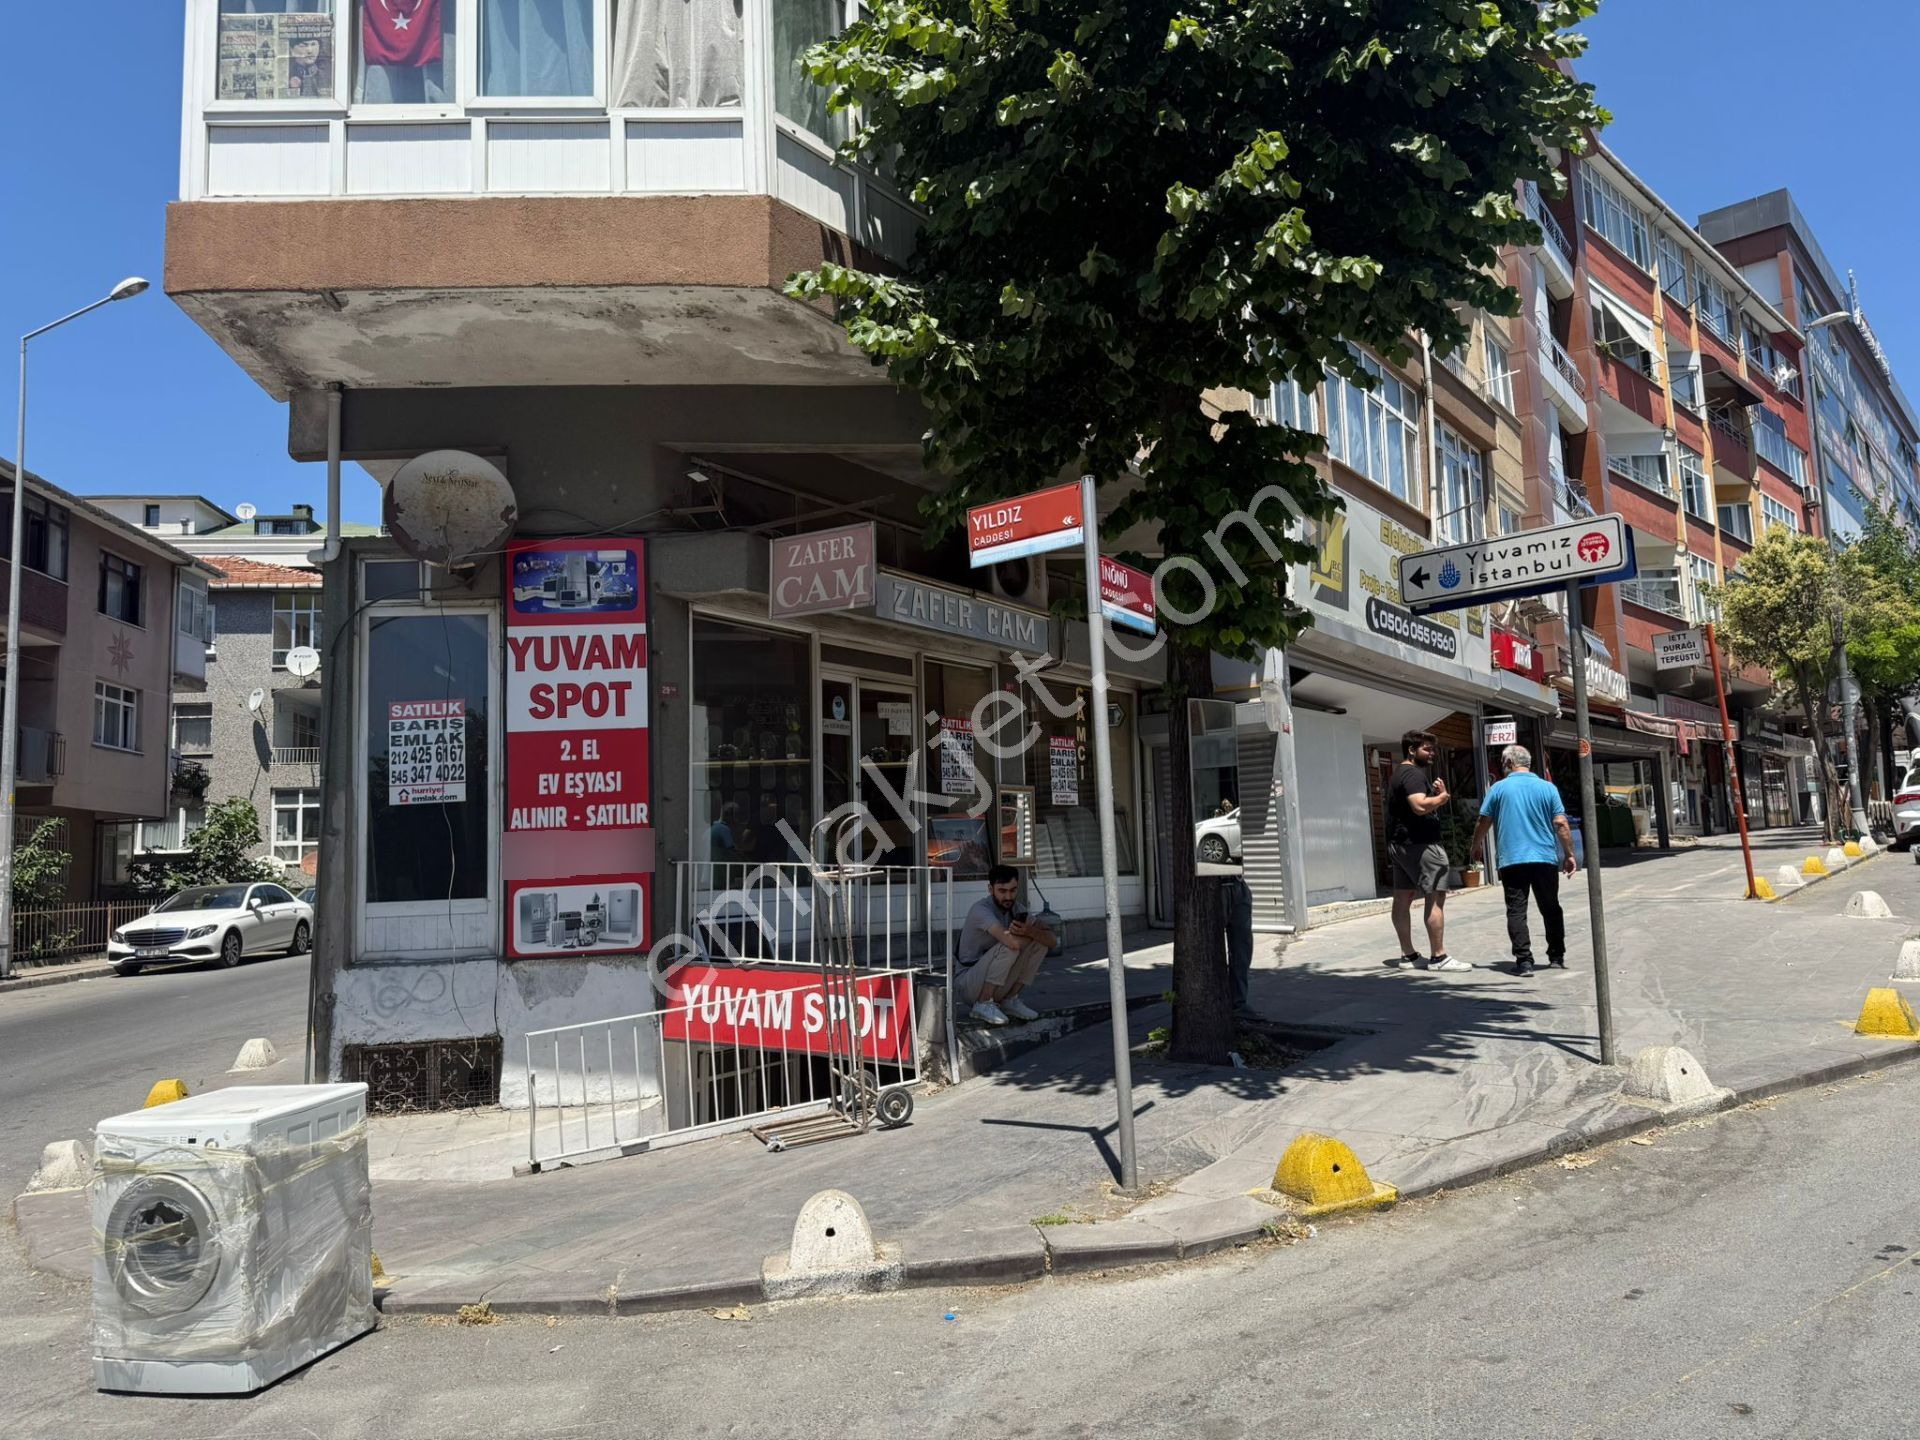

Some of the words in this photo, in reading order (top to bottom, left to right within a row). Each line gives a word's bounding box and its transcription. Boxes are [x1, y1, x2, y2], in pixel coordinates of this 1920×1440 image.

[973, 505, 1022, 531] YILDIZ
[788, 535, 856, 568] ZAFER
[1466, 537, 1571, 565] Yuvamız
[1101, 561, 1128, 589] İNÖNÜ
[1469, 554, 1572, 584] İstanbul
[776, 563, 868, 608] CAM
[892, 582, 973, 630] ZAFER
[986, 606, 1036, 645] CAM
[1380, 610, 1409, 636] 0506
[1410, 622, 1430, 644] 055
[1431, 631, 1455, 653] 9560
[507, 633, 647, 672] YUVAM
[1660, 652, 1701, 664] TEPEÜSTÜ
[1663, 641, 1696, 652] DURAĞI
[391, 702, 462, 717] SATILIK
[529, 681, 632, 720] SPOT
[390, 718, 464, 732] BARIŞ
[1486, 730, 1515, 743] TERZİ
[390, 732, 463, 747] EMLAK
[560, 739, 577, 761] 2.
[583, 739, 600, 760] EL
[391, 751, 408, 765] 212
[411, 746, 432, 763] 425
[436, 745, 464, 762] 6167
[391, 770, 408, 784] 545
[411, 765, 432, 783] 347
[436, 764, 465, 781] 4022
[539, 773, 559, 795] EV
[565, 771, 622, 798] EŞYASI
[511, 806, 567, 829] ALINIR
[586, 803, 648, 827] SATILIR
[682, 983, 794, 1031] YUVAM
[802, 992, 895, 1040] SPOT
